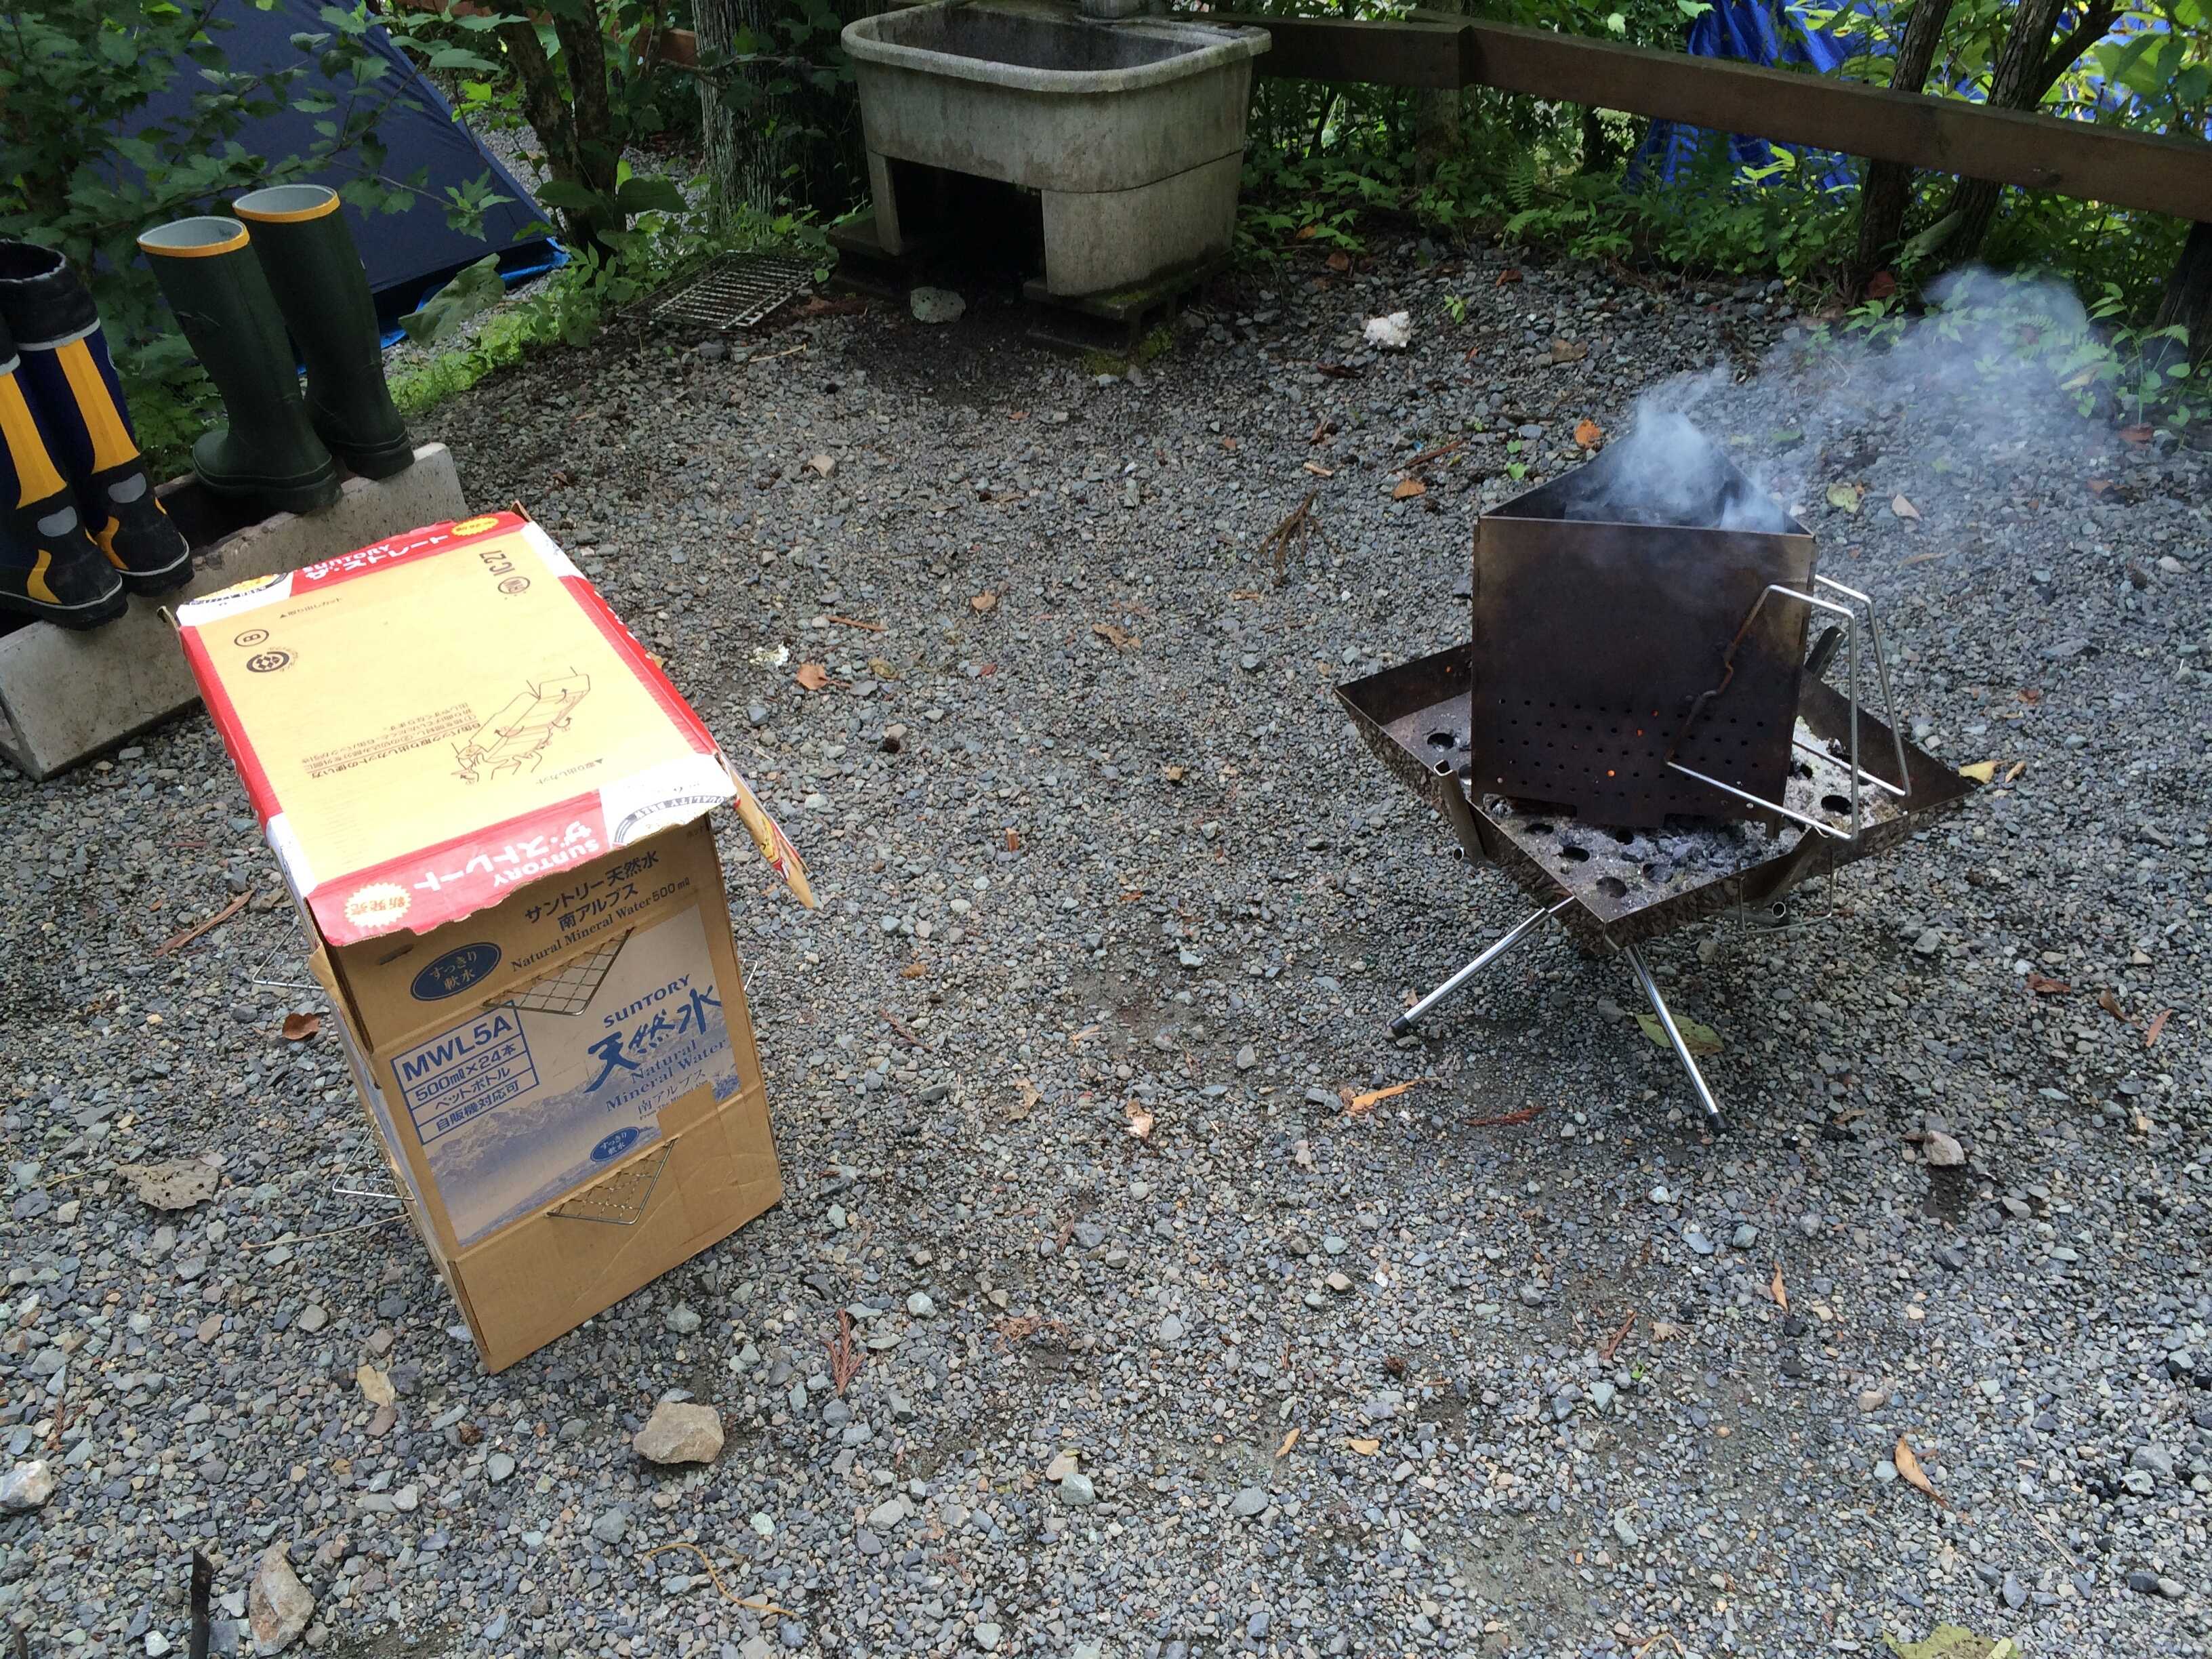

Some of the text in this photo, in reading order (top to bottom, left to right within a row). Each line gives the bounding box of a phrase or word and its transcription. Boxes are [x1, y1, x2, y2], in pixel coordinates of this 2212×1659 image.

[413, 821, 592, 891] ザ・ストレート
[493, 839, 600, 887] SUNTORY
[558, 883, 638, 931] 南アルプス
[510, 939, 561, 972] Natural
[565, 914, 613, 946] Mineral
[615, 896, 651, 919] Water
[429, 951, 477, 981] すっきり
[445, 969, 475, 990] 軟水
[604, 974, 690, 1028] SUNTORY
[402, 1015, 512, 1082] MWL5A
[583, 985, 722, 1094] 天然水
[630, 1040, 697, 1084] Natural
[606, 1069, 674, 1112] Mineral
[678, 1040, 726, 1070] Water
[437, 1080, 519, 1132] 自販機対応可
[600, 1132, 627, 1150] すっきり
